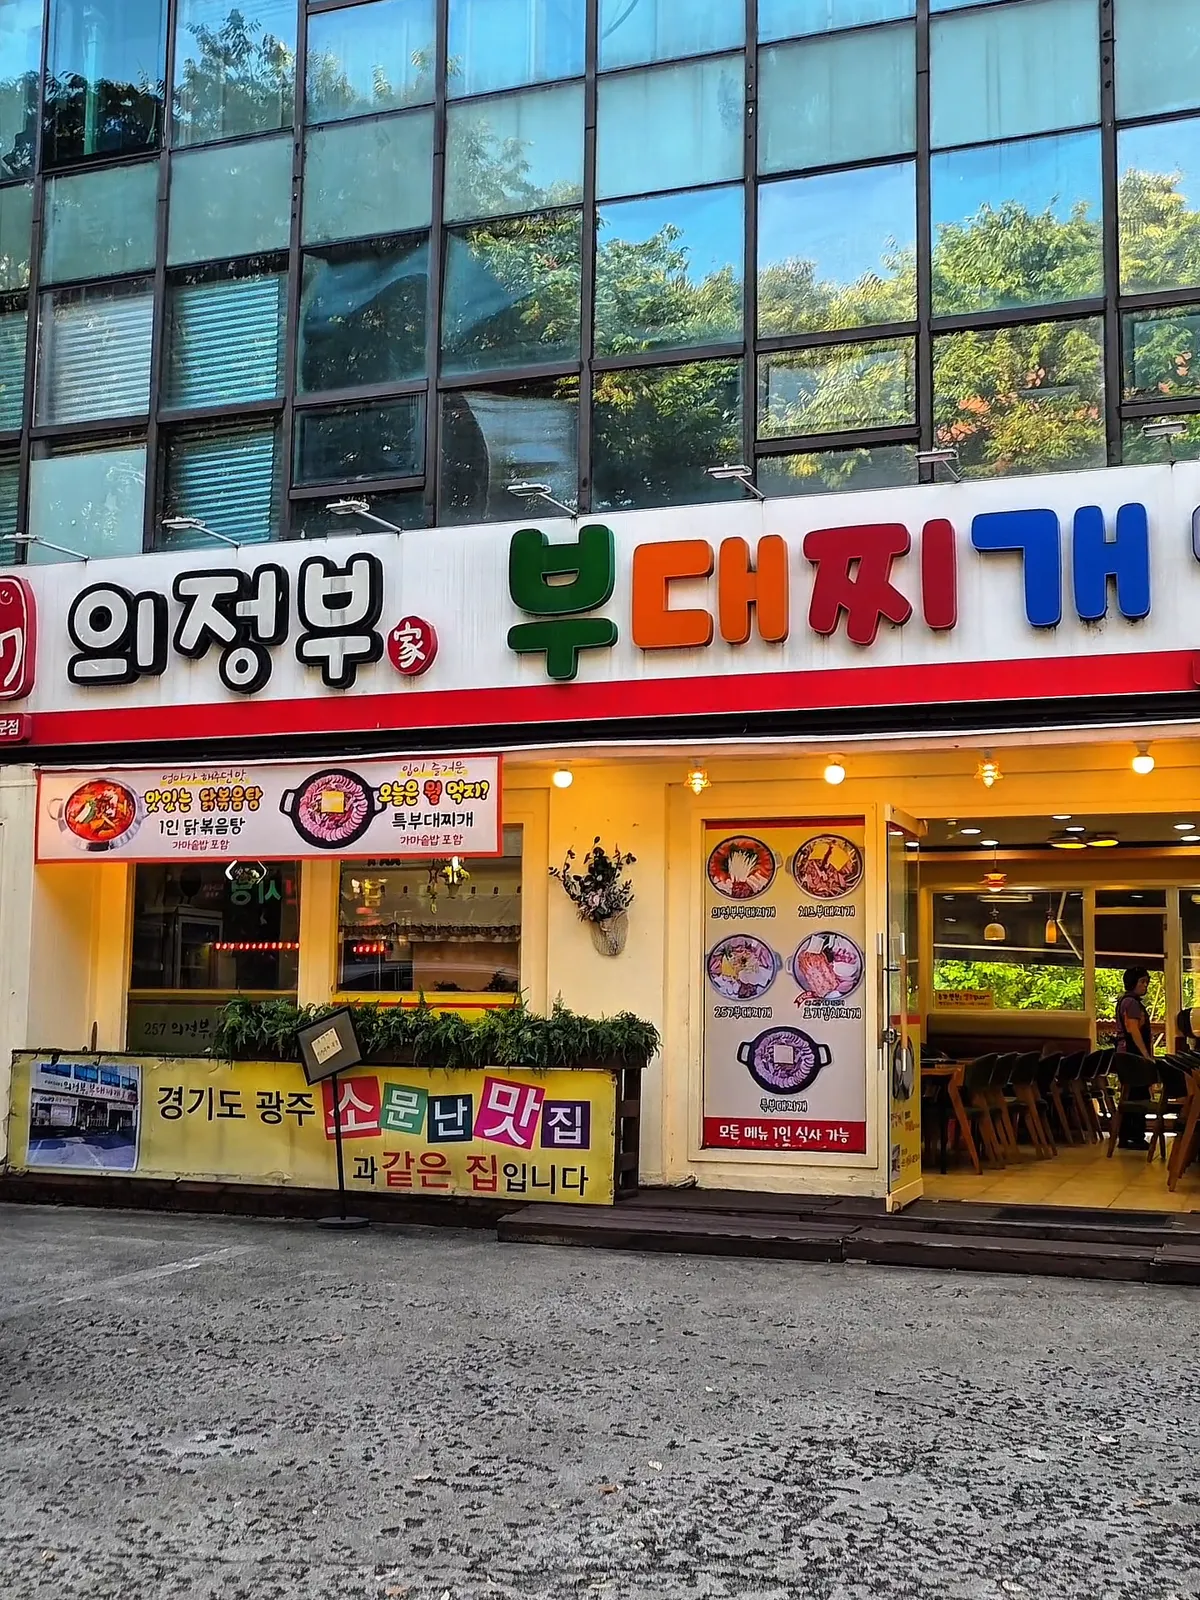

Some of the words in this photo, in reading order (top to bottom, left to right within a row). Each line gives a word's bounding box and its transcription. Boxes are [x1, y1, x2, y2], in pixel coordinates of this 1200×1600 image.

[68, 552, 384, 694] 의정부
[507, 502, 1151, 681] 부대찌개
[402, 763, 425, 776] 입이
[431, 761, 465, 776] 즐거운
[161, 772, 198, 785] 엄마가
[144, 787, 193, 813] 맛있는
[199, 785, 264, 812] 닭볶음탕
[377, 779, 420, 806] 오늘은
[446, 779, 490, 804] 먹지?
[159, 818, 180, 836] 1인
[184, 817, 246, 836] 닭볶음탕
[391, 811, 474, 831] 특부대찌개
[210, 839, 230, 850] 포함
[400, 834, 440, 846] 가마솥밥
[442, 834, 464, 846] 포함
[144, 1022, 167, 1036] 257
[172, 1018, 210, 1040] 의정부
[157, 1085, 246, 1121] 경기도
[255, 1090, 316, 1126] 광주
[719, 1124, 741, 1141] 모든
[744, 1126, 769, 1141] 메뉴
[772, 1126, 791, 1142] 1인
[795, 1126, 822, 1143] 식사
[825, 1127, 850, 1143] 가능
